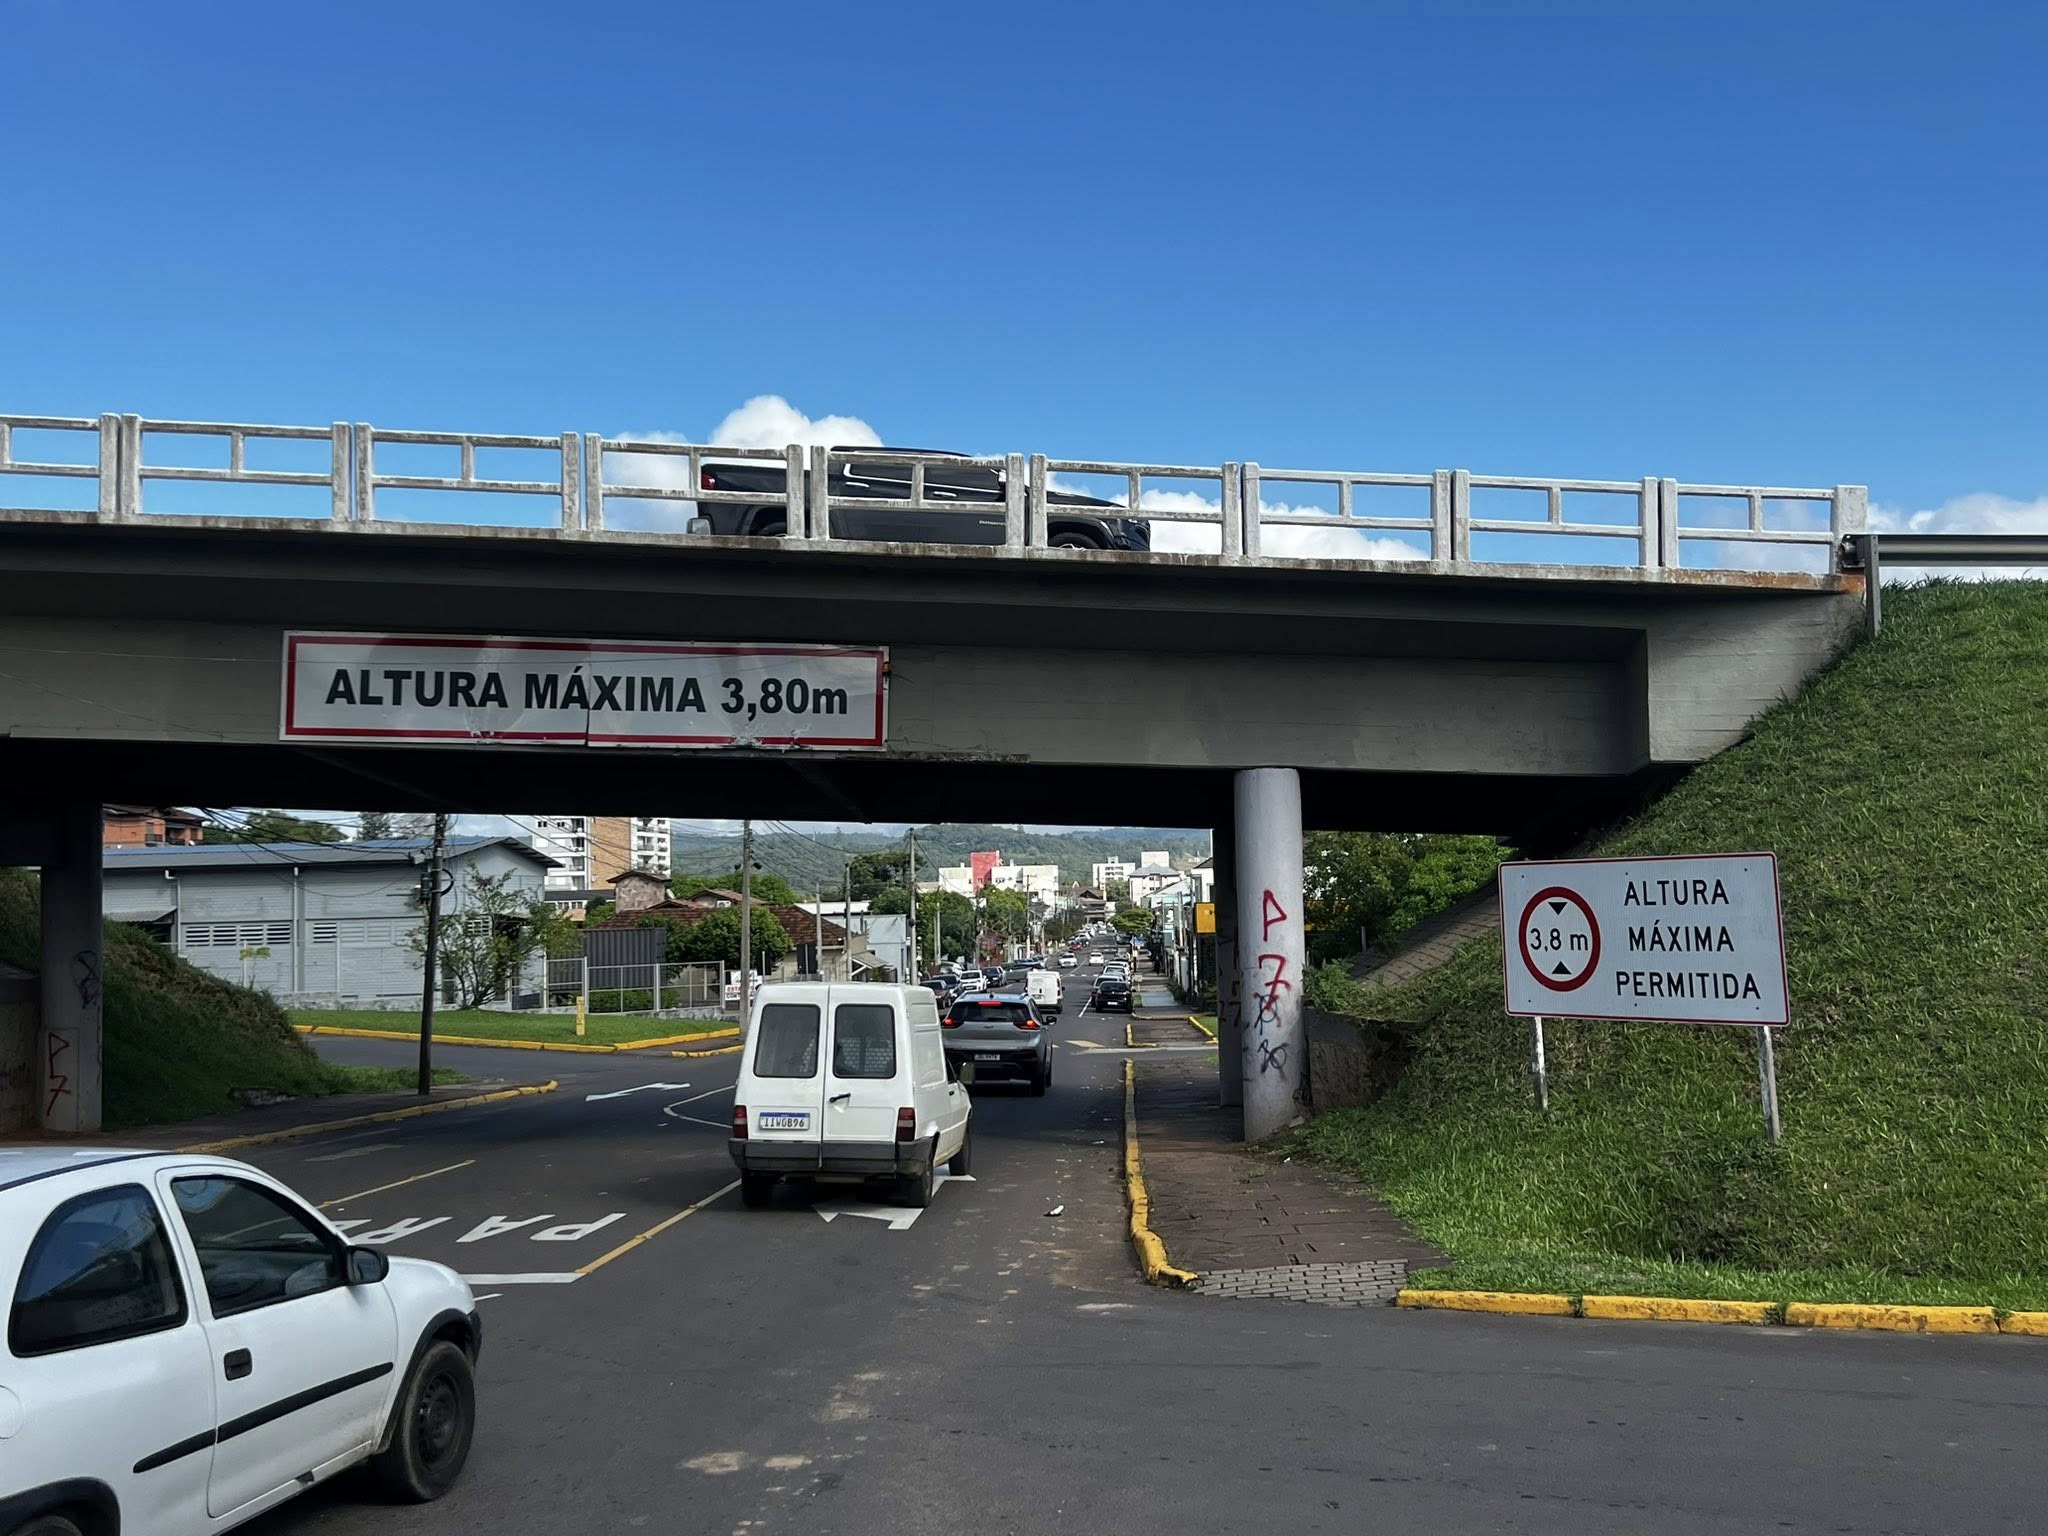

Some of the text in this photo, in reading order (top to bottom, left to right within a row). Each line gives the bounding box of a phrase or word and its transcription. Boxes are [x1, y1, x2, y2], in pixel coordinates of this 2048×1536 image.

[326, 665, 848, 721] ALTURA MÁXIMA 3,80m
[1624, 879, 1730, 906] ALTURA
[1530, 928, 1588, 952] 3,8 m
[1629, 919, 1735, 951] MÁXIMA
[1616, 971, 1761, 999] PERMITIDA
